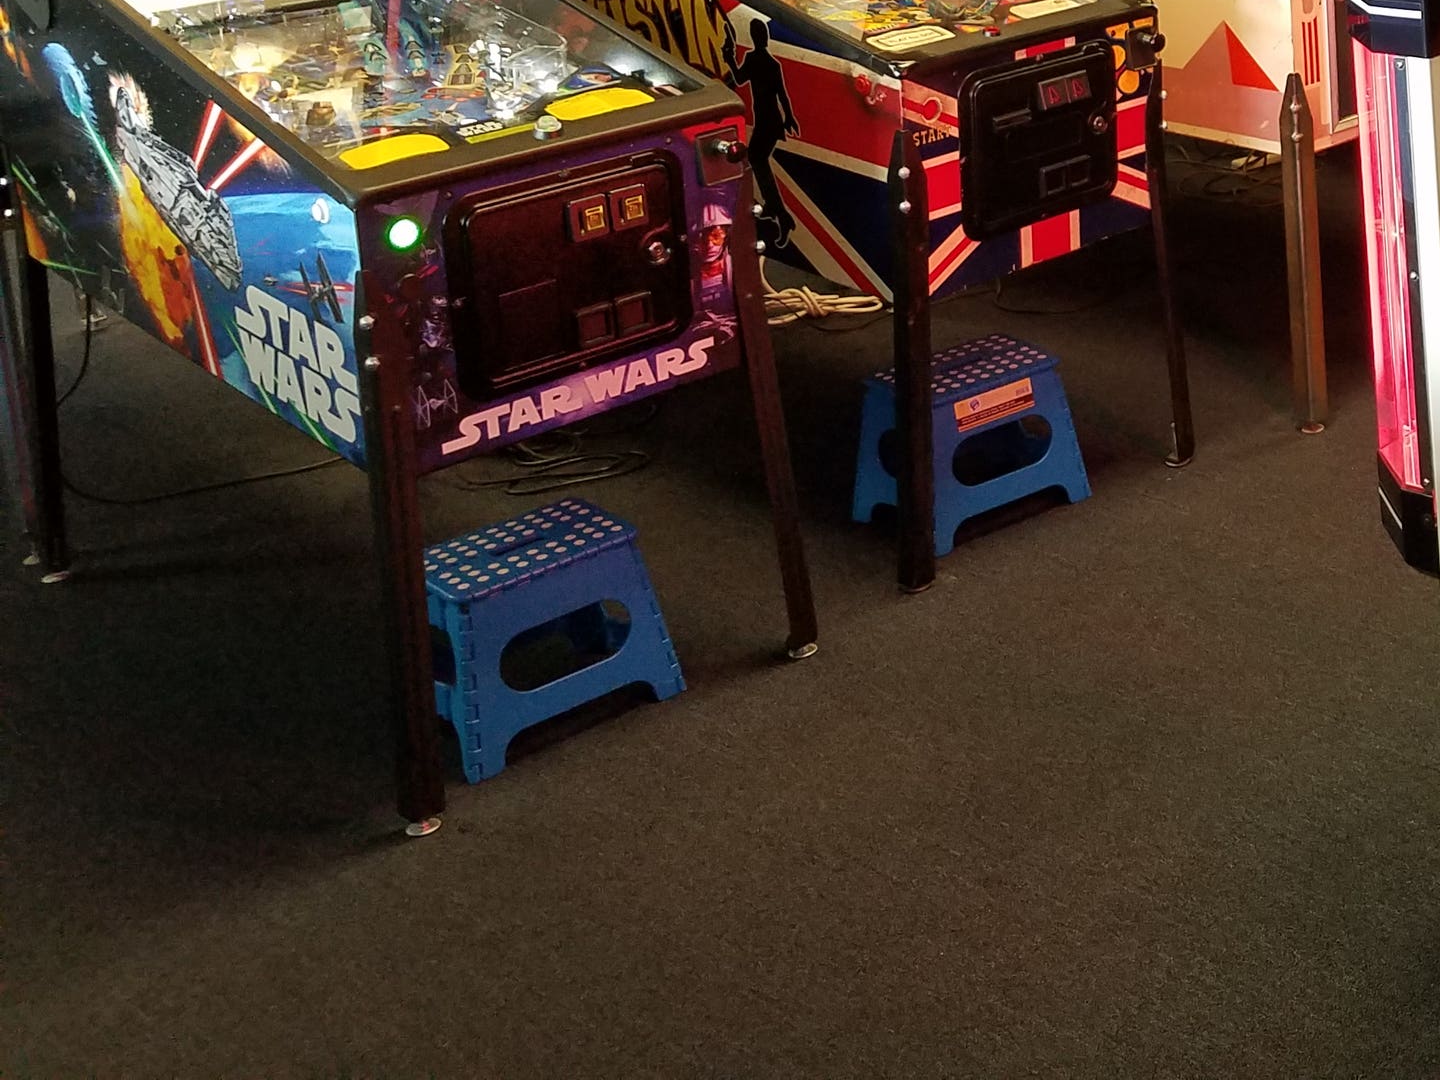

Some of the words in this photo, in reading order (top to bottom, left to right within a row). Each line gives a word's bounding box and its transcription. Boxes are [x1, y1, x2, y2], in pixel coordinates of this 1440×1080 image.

[912, 124, 953, 147] START
[234, 284, 359, 396] STAR
[237, 327, 362, 444] WARS
[441, 384, 584, 456] STAR
[584, 336, 715, 405] WARS
